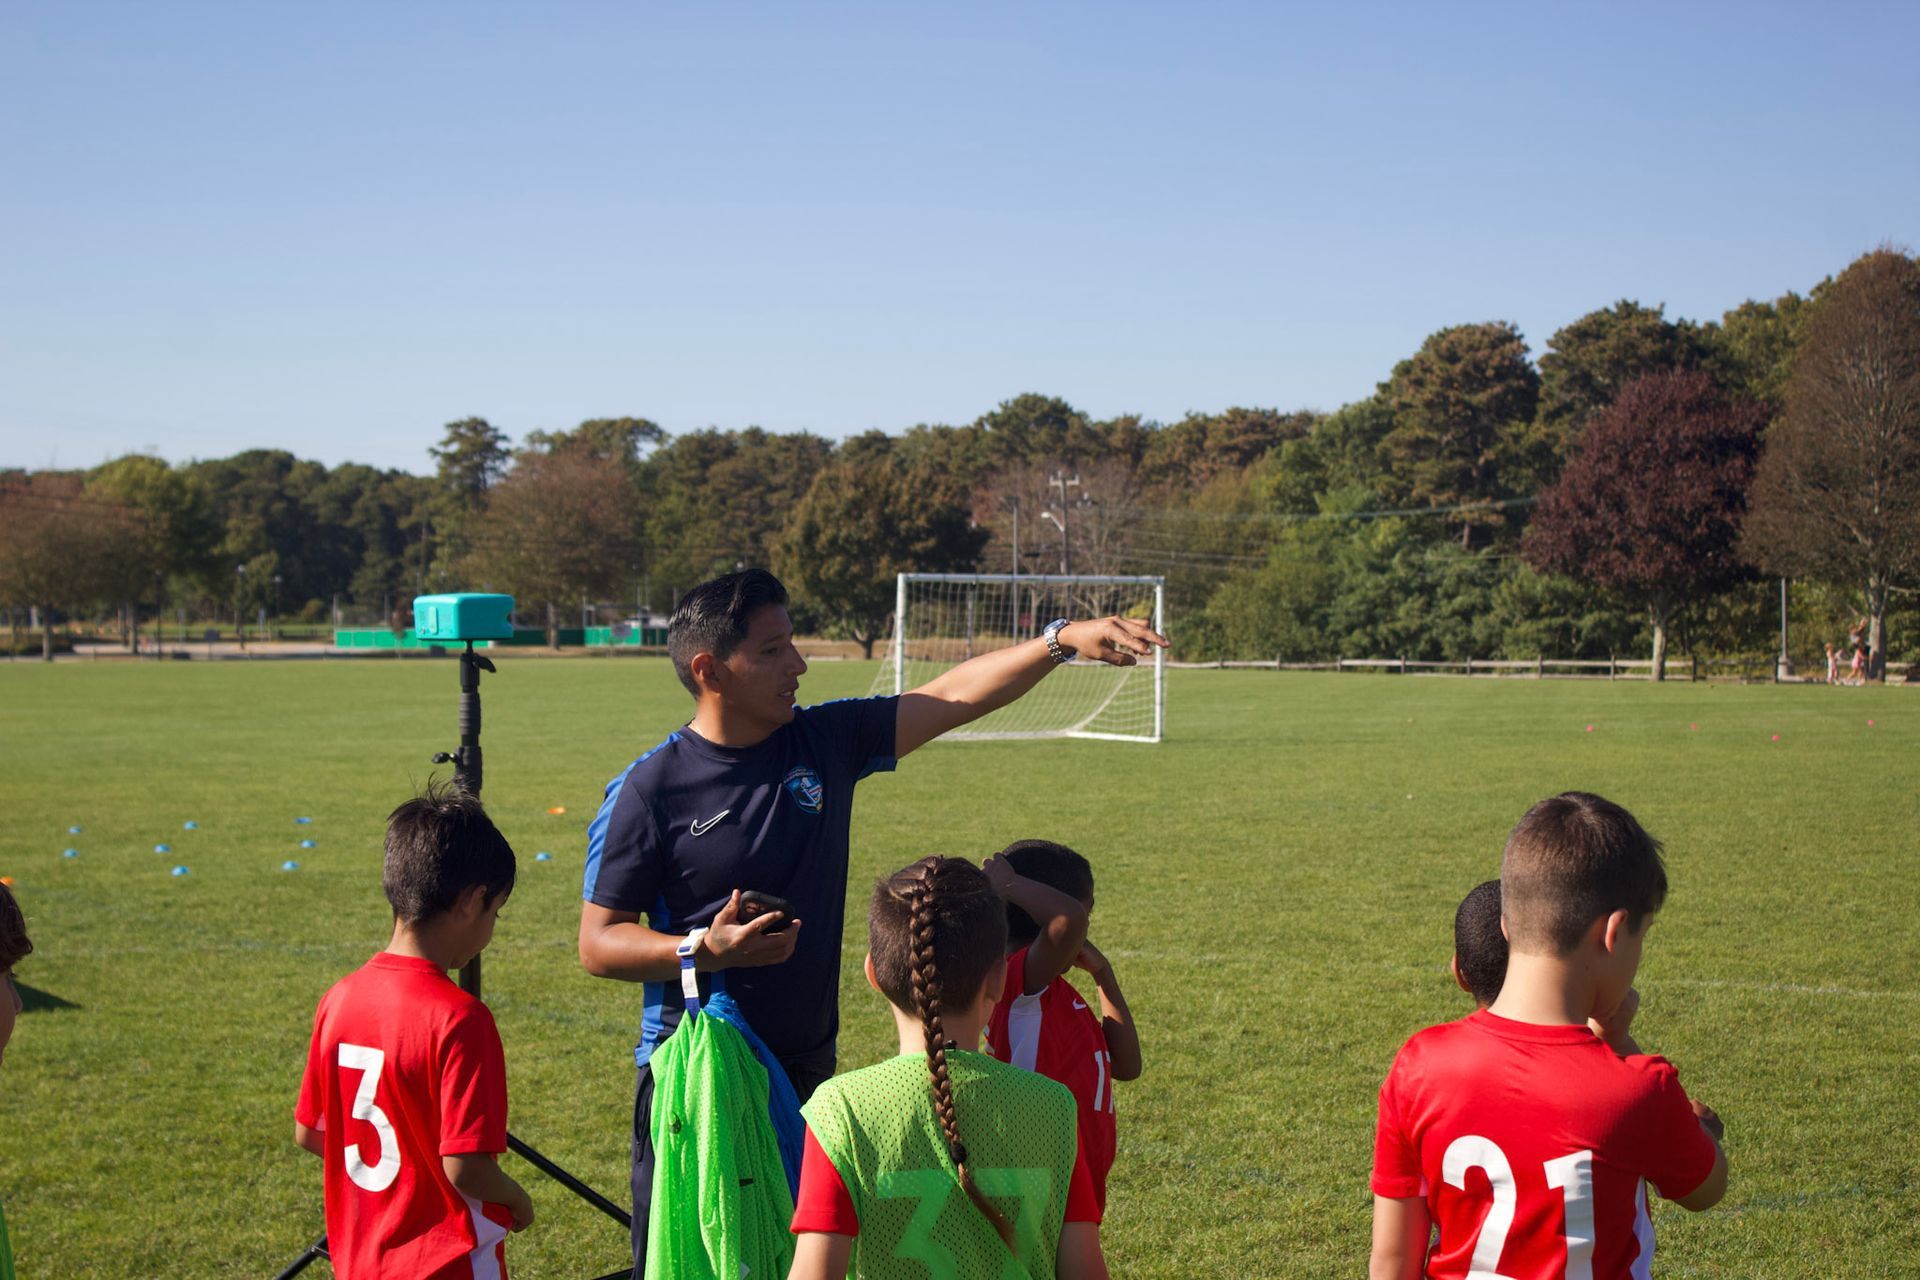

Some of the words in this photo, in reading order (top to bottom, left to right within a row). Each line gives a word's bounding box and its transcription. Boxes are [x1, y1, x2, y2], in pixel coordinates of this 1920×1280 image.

[338, 1043, 401, 1192] 3
[876, 1167, 1052, 1280] 37
[1442, 1134, 1596, 1280] 21
